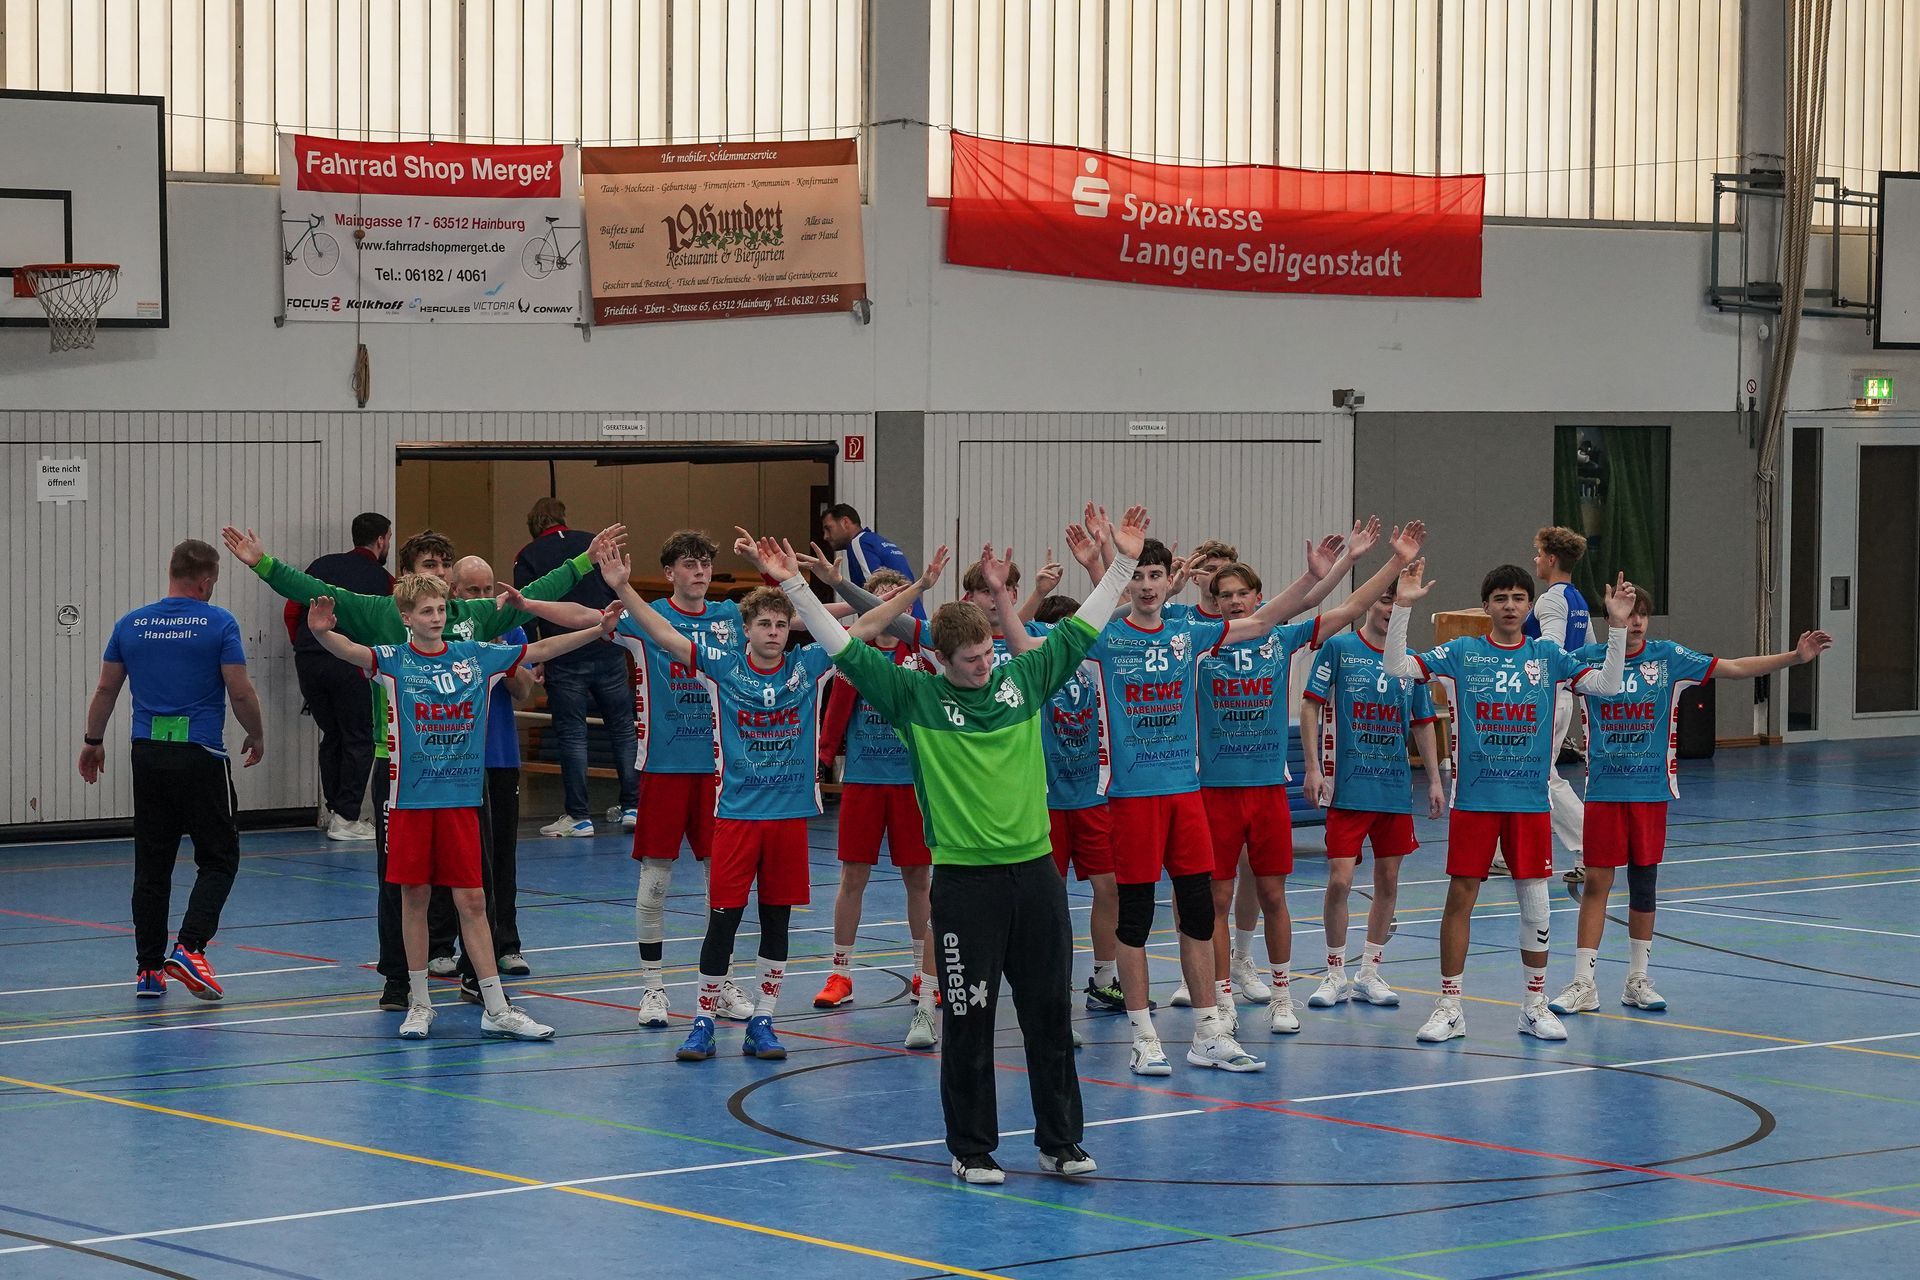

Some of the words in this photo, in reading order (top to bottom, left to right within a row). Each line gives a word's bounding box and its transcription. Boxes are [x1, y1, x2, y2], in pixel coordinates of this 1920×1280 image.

[661, 152, 674, 164] Ihr
[677, 151, 707, 163] mobiler
[708, 149, 777, 163] Schlemmerservice
[306, 151, 397, 177] Fahrrad
[404, 155, 465, 184] Shop
[472, 158, 553, 186] Merget
[624, 183, 655, 193] Hochzeit
[661, 182, 697, 194] Geburtstag
[703, 179, 745, 192] Firmenfeiern
[751, 179, 790, 189] Kommunion
[797, 177, 838, 188] Konfirmation
[1121, 193, 1263, 232] Sparkasse
[335, 213, 402, 229] Maingasse
[408, 216, 421, 228] 17
[433, 217, 469, 229] 63512
[472, 218, 526, 232] Hainburg
[804, 216, 820, 226] Alles
[630, 224, 645, 233] und
[801, 232, 817, 240] einer
[818, 229, 839, 240] Hand
[355, 240, 506, 254] www.fahrradshopmerget.de
[609, 240, 635, 250] Menüs
[666, 251, 718, 269] Restaurant
[720, 249, 731, 263] &
[734, 248, 784, 269] Biergarten
[1120, 233, 1402, 281] Langen-Seligenstadt
[375, 268, 401, 281] Tel.:
[405, 269, 444, 282] 06182
[456, 269, 487, 282] 4061
[602, 281, 629, 292] Geschirr
[631, 280, 643, 288] und
[645, 278, 672, 289] Besteck
[677, 277, 695, 287] Tisch
[697, 276, 709, 285] und
[758, 273, 774, 282] Wein
[775, 272, 787, 281] und
[287, 298, 329, 308] FOCUS
[346, 299, 404, 310] Kalkhoff
[473, 301, 515, 311] VICTORIA
[604, 304, 637, 317] Friedrich
[644, 303, 665, 314] Ebert
[672, 303, 697, 313] Strasse
[699, 301, 711, 312] 65,
[712, 300, 735, 311] 63512
[737, 298, 773, 311] Hainburg,
[792, 296, 814, 305] 06182
[820, 294, 839, 304] 5346
[42, 465, 60, 473] Bitte
[61, 465, 81, 473] nicht
[47, 478, 75, 487] öffnen!
[133, 618, 148, 626] SG
[151, 617, 208, 626] HAINBURG
[692, 631, 706, 647] 11
[1110, 636, 1147, 646] VEPRO
[1145, 649, 1168, 672] 25
[1233, 649, 1253, 671] 15
[1341, 657, 1374, 665] VEPRO
[1466, 656, 1499, 664] VEPRO
[432, 672, 456, 694] 10
[671, 683, 707, 691] BABENH
[1212, 678, 1273, 697] REWE
[1376, 672, 1388, 693] 6
[1496, 671, 1522, 693] 24
[763, 687, 776, 707] 8
[1070, 684, 1080, 705] 9
[1125, 680, 1183, 703] REWE
[679, 694, 711, 704] ALUC
[415, 701, 475, 720] REWE
[738, 707, 800, 727] REWE
[944, 706, 965, 726] 16
[1476, 702, 1537, 722] REWE
[1601, 703, 1656, 721] REWE
[676, 727, 712, 735] FINANZ
[1476, 724, 1537, 734] BABENHAUSEN
[1601, 723, 1655, 732] BABENHAUSEN
[862, 747, 907, 755] FINANZRA
[1219, 743, 1279, 752] FINANZRATH
[1135, 750, 1190, 761] FINANZRATH
[421, 767, 480, 777] FINANZRATH
[1354, 766, 1405, 777] FINANZRATH
[1480, 768, 1541, 778] FINANZRATH
[1602, 765, 1660, 773] FINANZRATH
[744, 774, 805, 784] FINANZRATH
[943, 933, 967, 1016] entega
